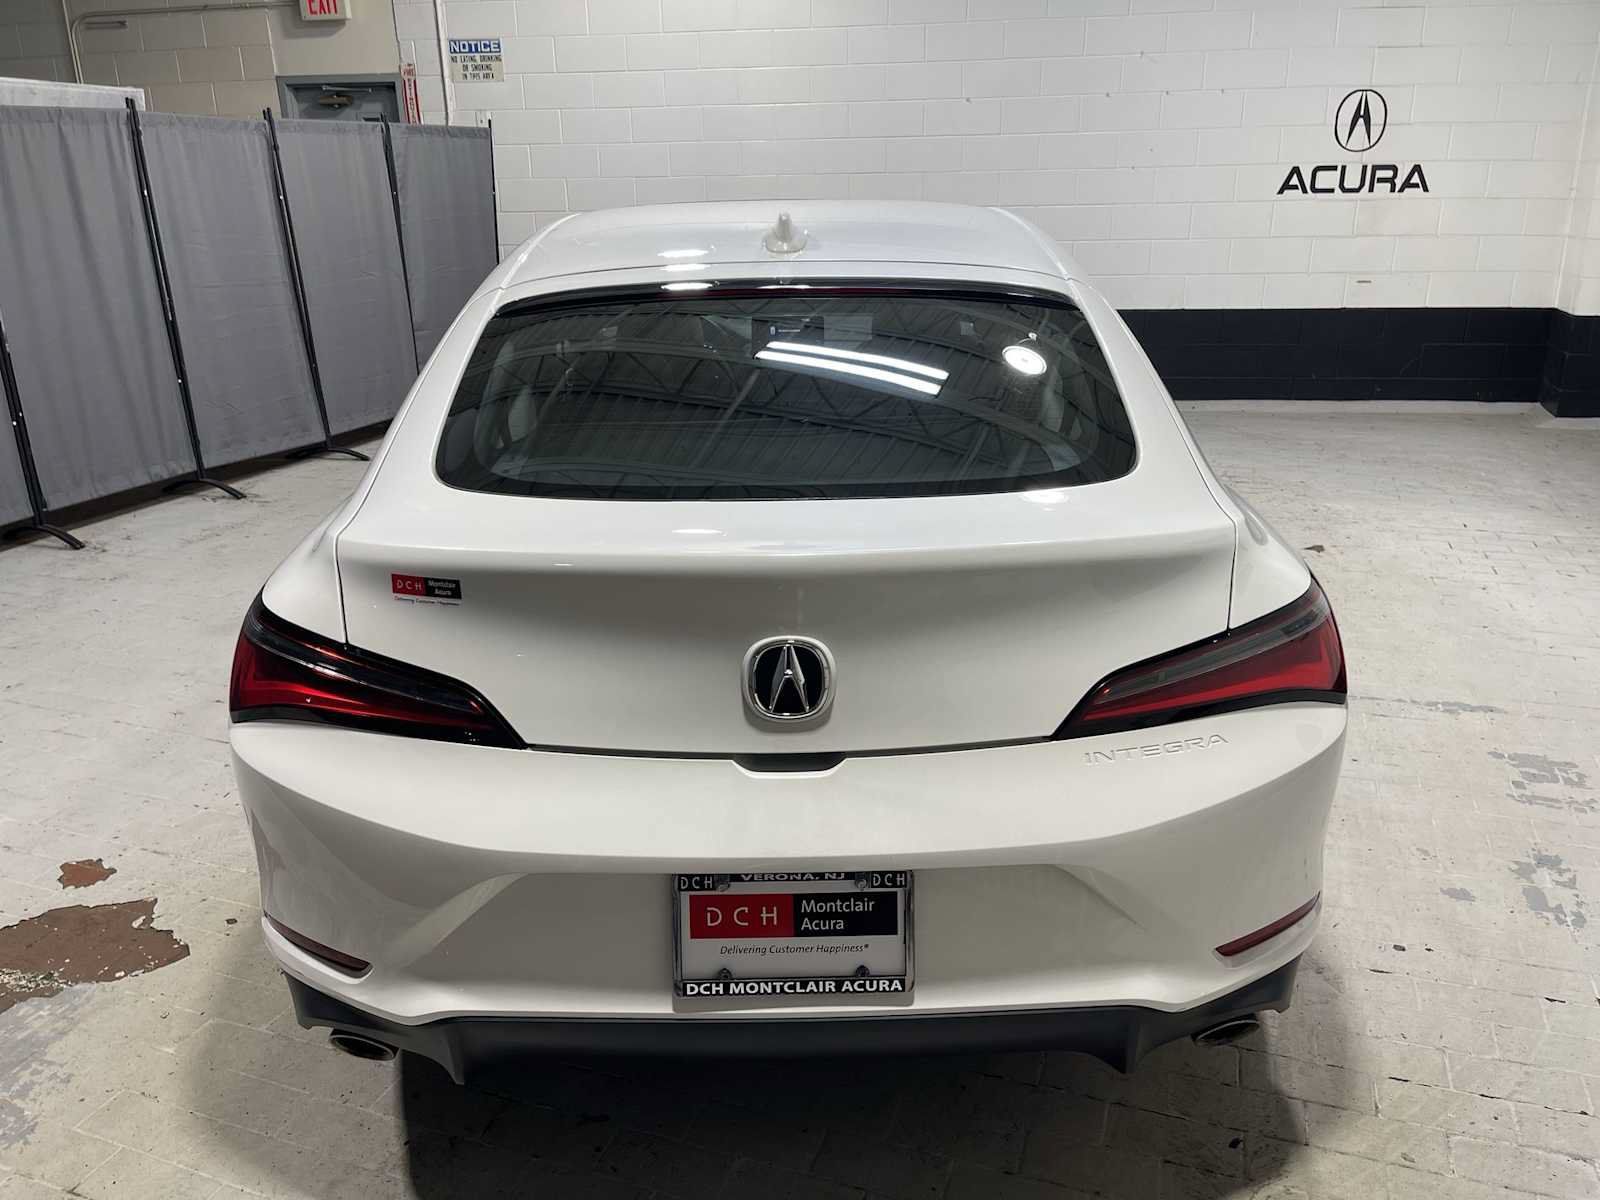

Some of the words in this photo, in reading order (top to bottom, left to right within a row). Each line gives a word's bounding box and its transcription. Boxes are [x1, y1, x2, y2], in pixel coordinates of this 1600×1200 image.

[450, 40, 500, 53] NOTICE
[1276, 164, 1430, 195] ACURA
[396, 579, 422, 591] DCH
[1083, 734, 1229, 765] INTEGRA
[680, 875, 713, 890] DCH
[824, 872, 845, 880] NJ
[872, 873, 905, 887] DCH
[801, 898, 875, 912] Montclair
[706, 906, 777, 926] DCH
[801, 917, 844, 930] Acura
[720, 945, 767, 956] Delivering
[769, 944, 815, 954] Customer
[686, 983, 724, 996] DCH
[729, 980, 836, 994] MONTCLAIR
[841, 979, 903, 992] ACURA
